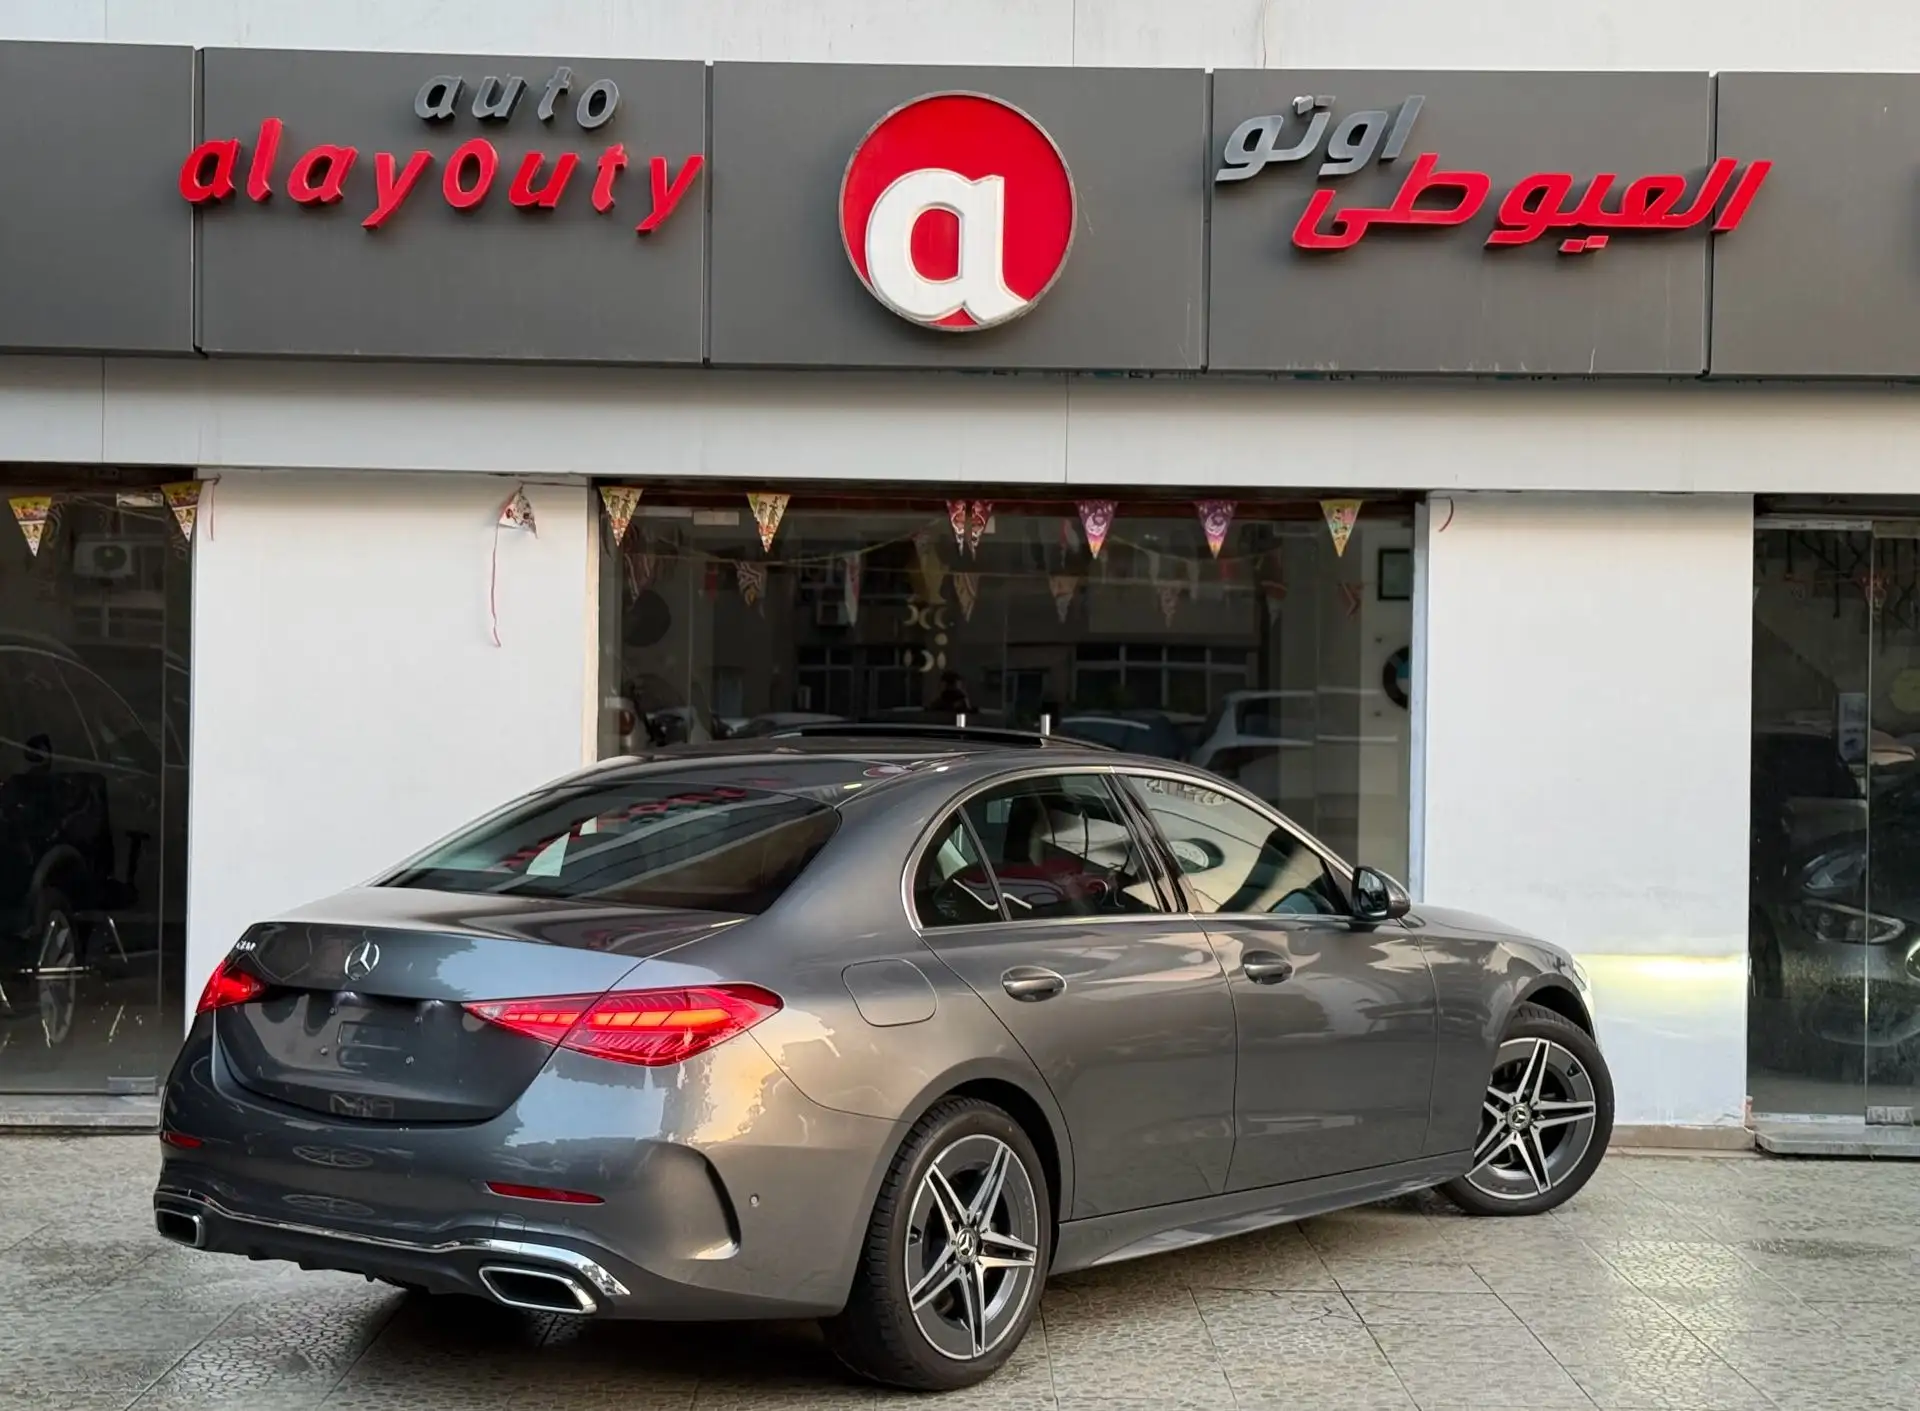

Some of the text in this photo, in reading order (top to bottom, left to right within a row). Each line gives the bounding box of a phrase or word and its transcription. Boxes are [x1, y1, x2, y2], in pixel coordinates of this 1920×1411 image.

[414, 66, 621, 129] auto
[1215, 95, 1425, 181] اوتو
[179, 117, 704, 232] alayouty
[865, 168, 1028, 323] a
